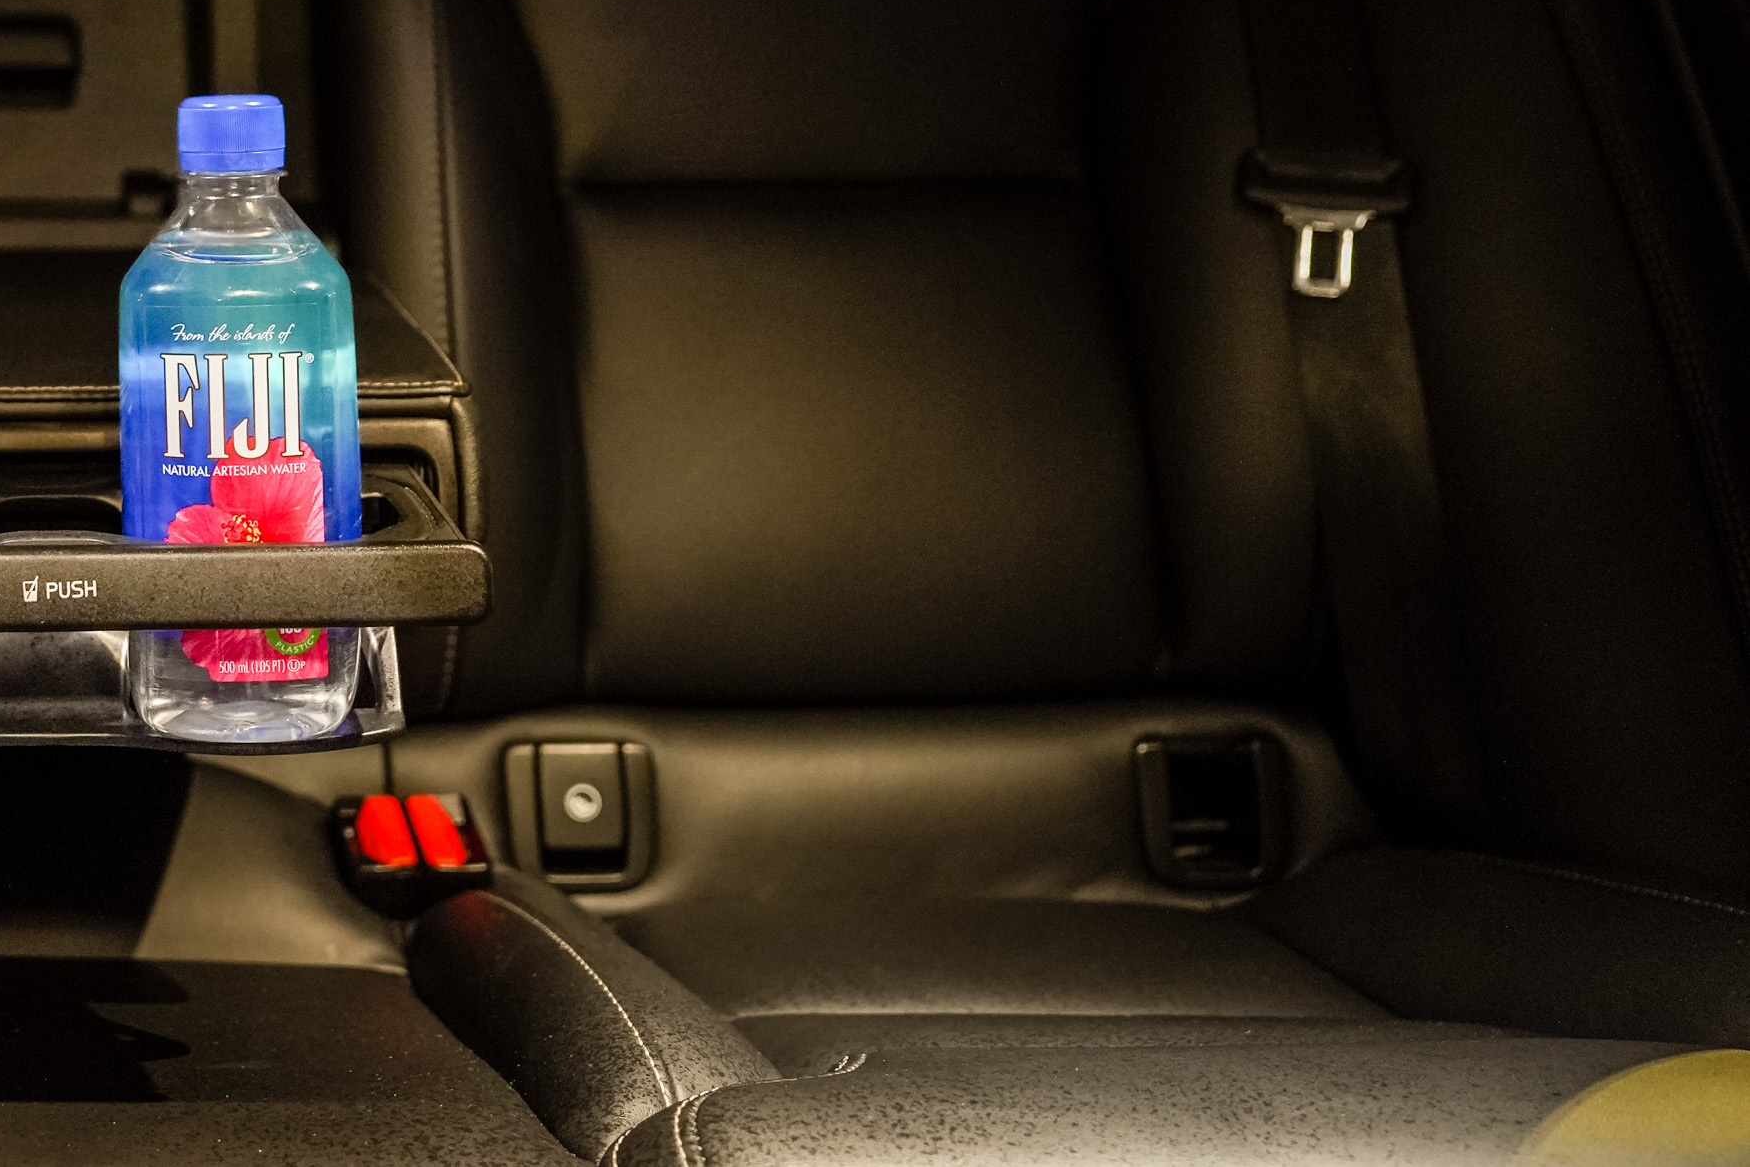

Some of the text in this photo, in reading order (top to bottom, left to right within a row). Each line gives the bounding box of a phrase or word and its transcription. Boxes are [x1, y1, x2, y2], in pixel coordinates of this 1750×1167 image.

[170, 323, 296, 345] From the islands of
[160, 351, 305, 459] FIJI
[162, 462, 306, 477] NATURAL ARTESIAN WATER
[45, 579, 97, 600] PUSH
[219, 660, 236, 674] 500
[238, 660, 250, 674] mL
[251, 660, 271, 674] (1.05
[272, 659, 286, 673] PT)
